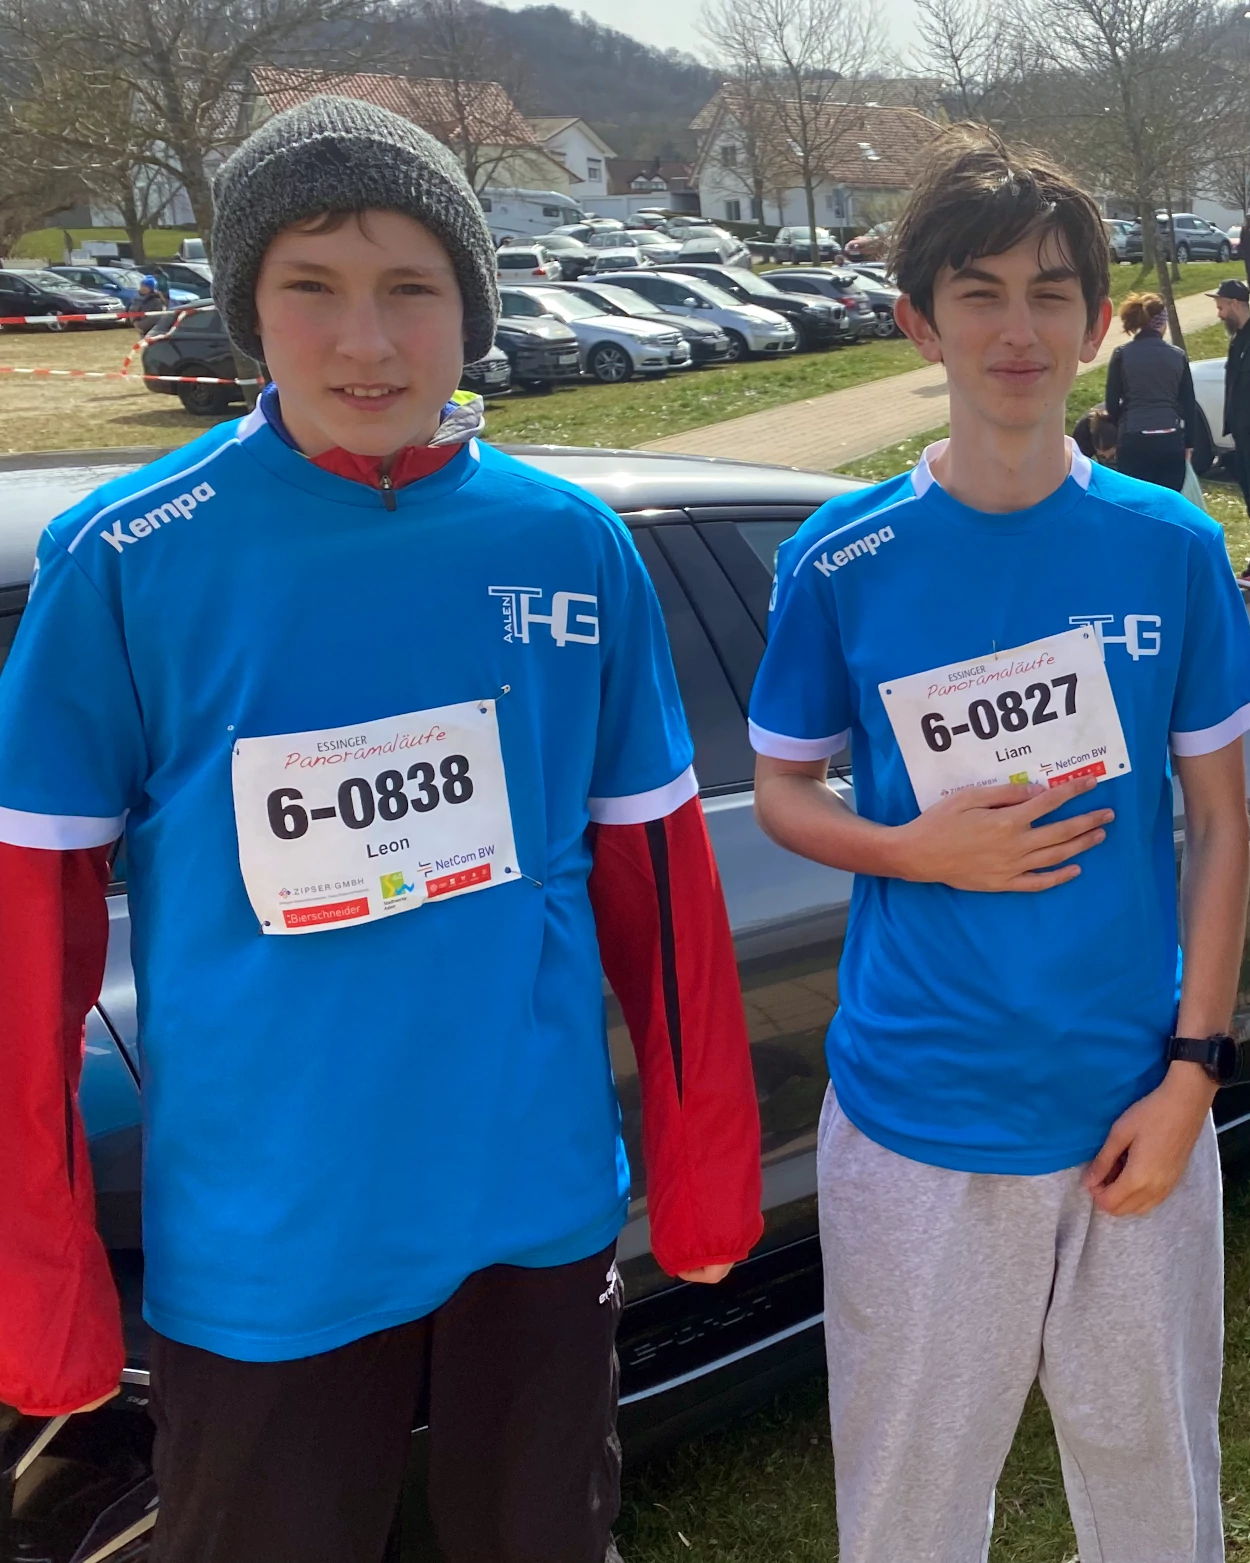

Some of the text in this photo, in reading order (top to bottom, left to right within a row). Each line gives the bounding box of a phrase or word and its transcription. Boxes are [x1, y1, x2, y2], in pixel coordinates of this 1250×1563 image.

[100, 481, 216, 553] Kempa
[813, 525, 895, 578] Kempa
[488, 586, 600, 647] THG
[502, 597, 513, 643] AALEN
[927, 652, 1056, 699] Panoramaläufe
[948, 665, 986, 682] ESSINGER
[920, 673, 1079, 753] 6-0827
[284, 725, 447, 770] Panoramaläufe
[317, 735, 367, 752] ESSINGER
[995, 743, 1032, 763] Liam
[1055, 746, 1107, 770] NetCom BW
[266, 754, 474, 840] 6-0838
[366, 837, 410, 859] Leon
[435, 845, 496, 871] NetCom BW
[293, 877, 365, 896] ZIPSER GMBH
